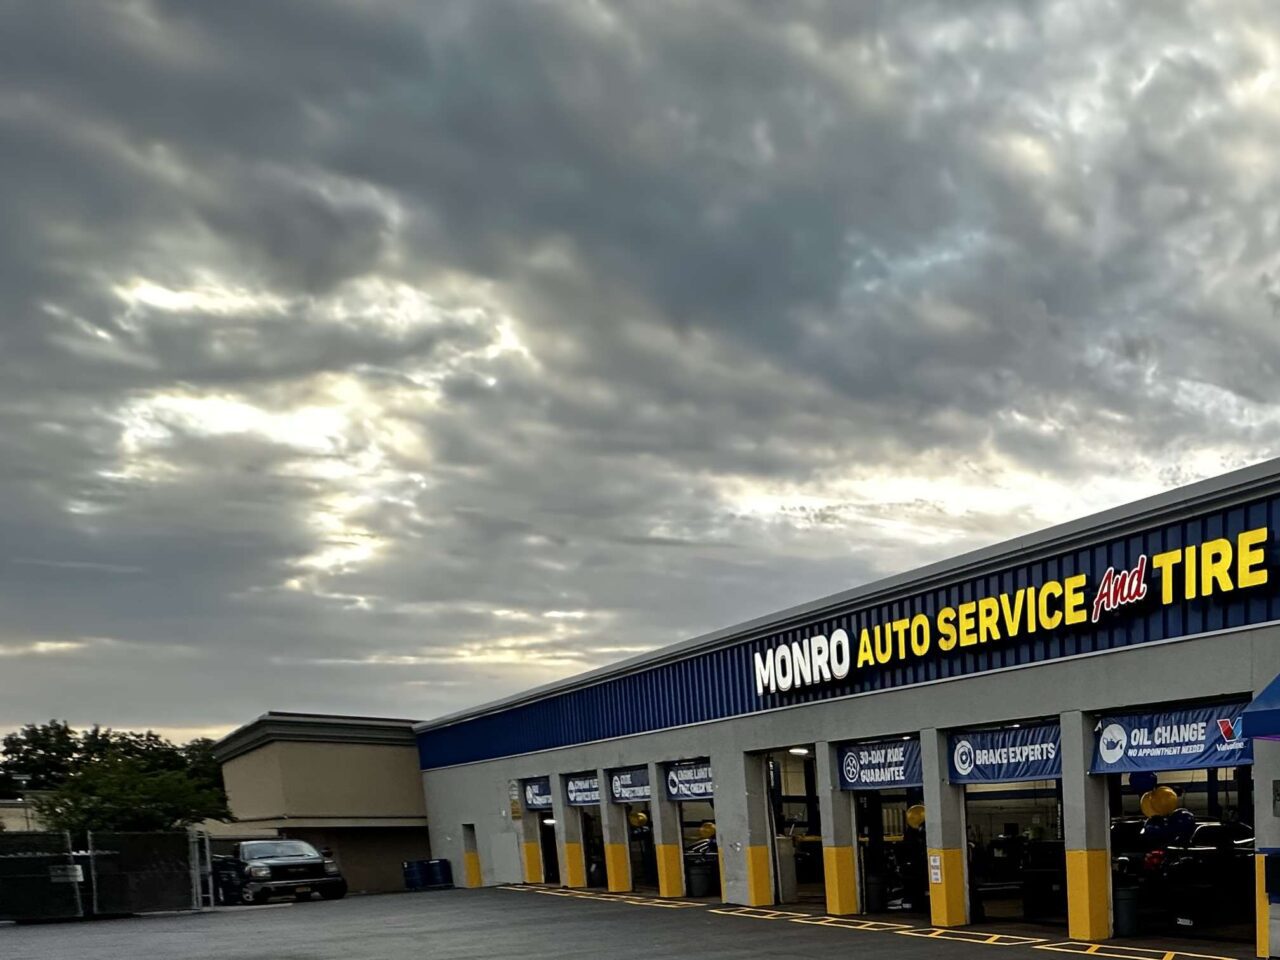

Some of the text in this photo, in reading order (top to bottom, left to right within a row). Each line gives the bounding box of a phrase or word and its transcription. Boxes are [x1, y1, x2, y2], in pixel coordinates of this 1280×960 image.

[753, 627, 852, 697] MONRO
[856, 613, 931, 669] AUTO
[937, 573, 1088, 652] SERVICE
[1092, 554, 1148, 624] And
[1152, 526, 1269, 606] TIRE
[1130, 722, 1207, 746] OIL CHANGE
[860, 747, 905, 765] 30-DAY RIDE
[975, 742, 1056, 765] BRAKE EXPERTS
[1127, 743, 1205, 757] NO APPOINTMENT NEEDED
[860, 766, 906, 783] GUARANTEE
